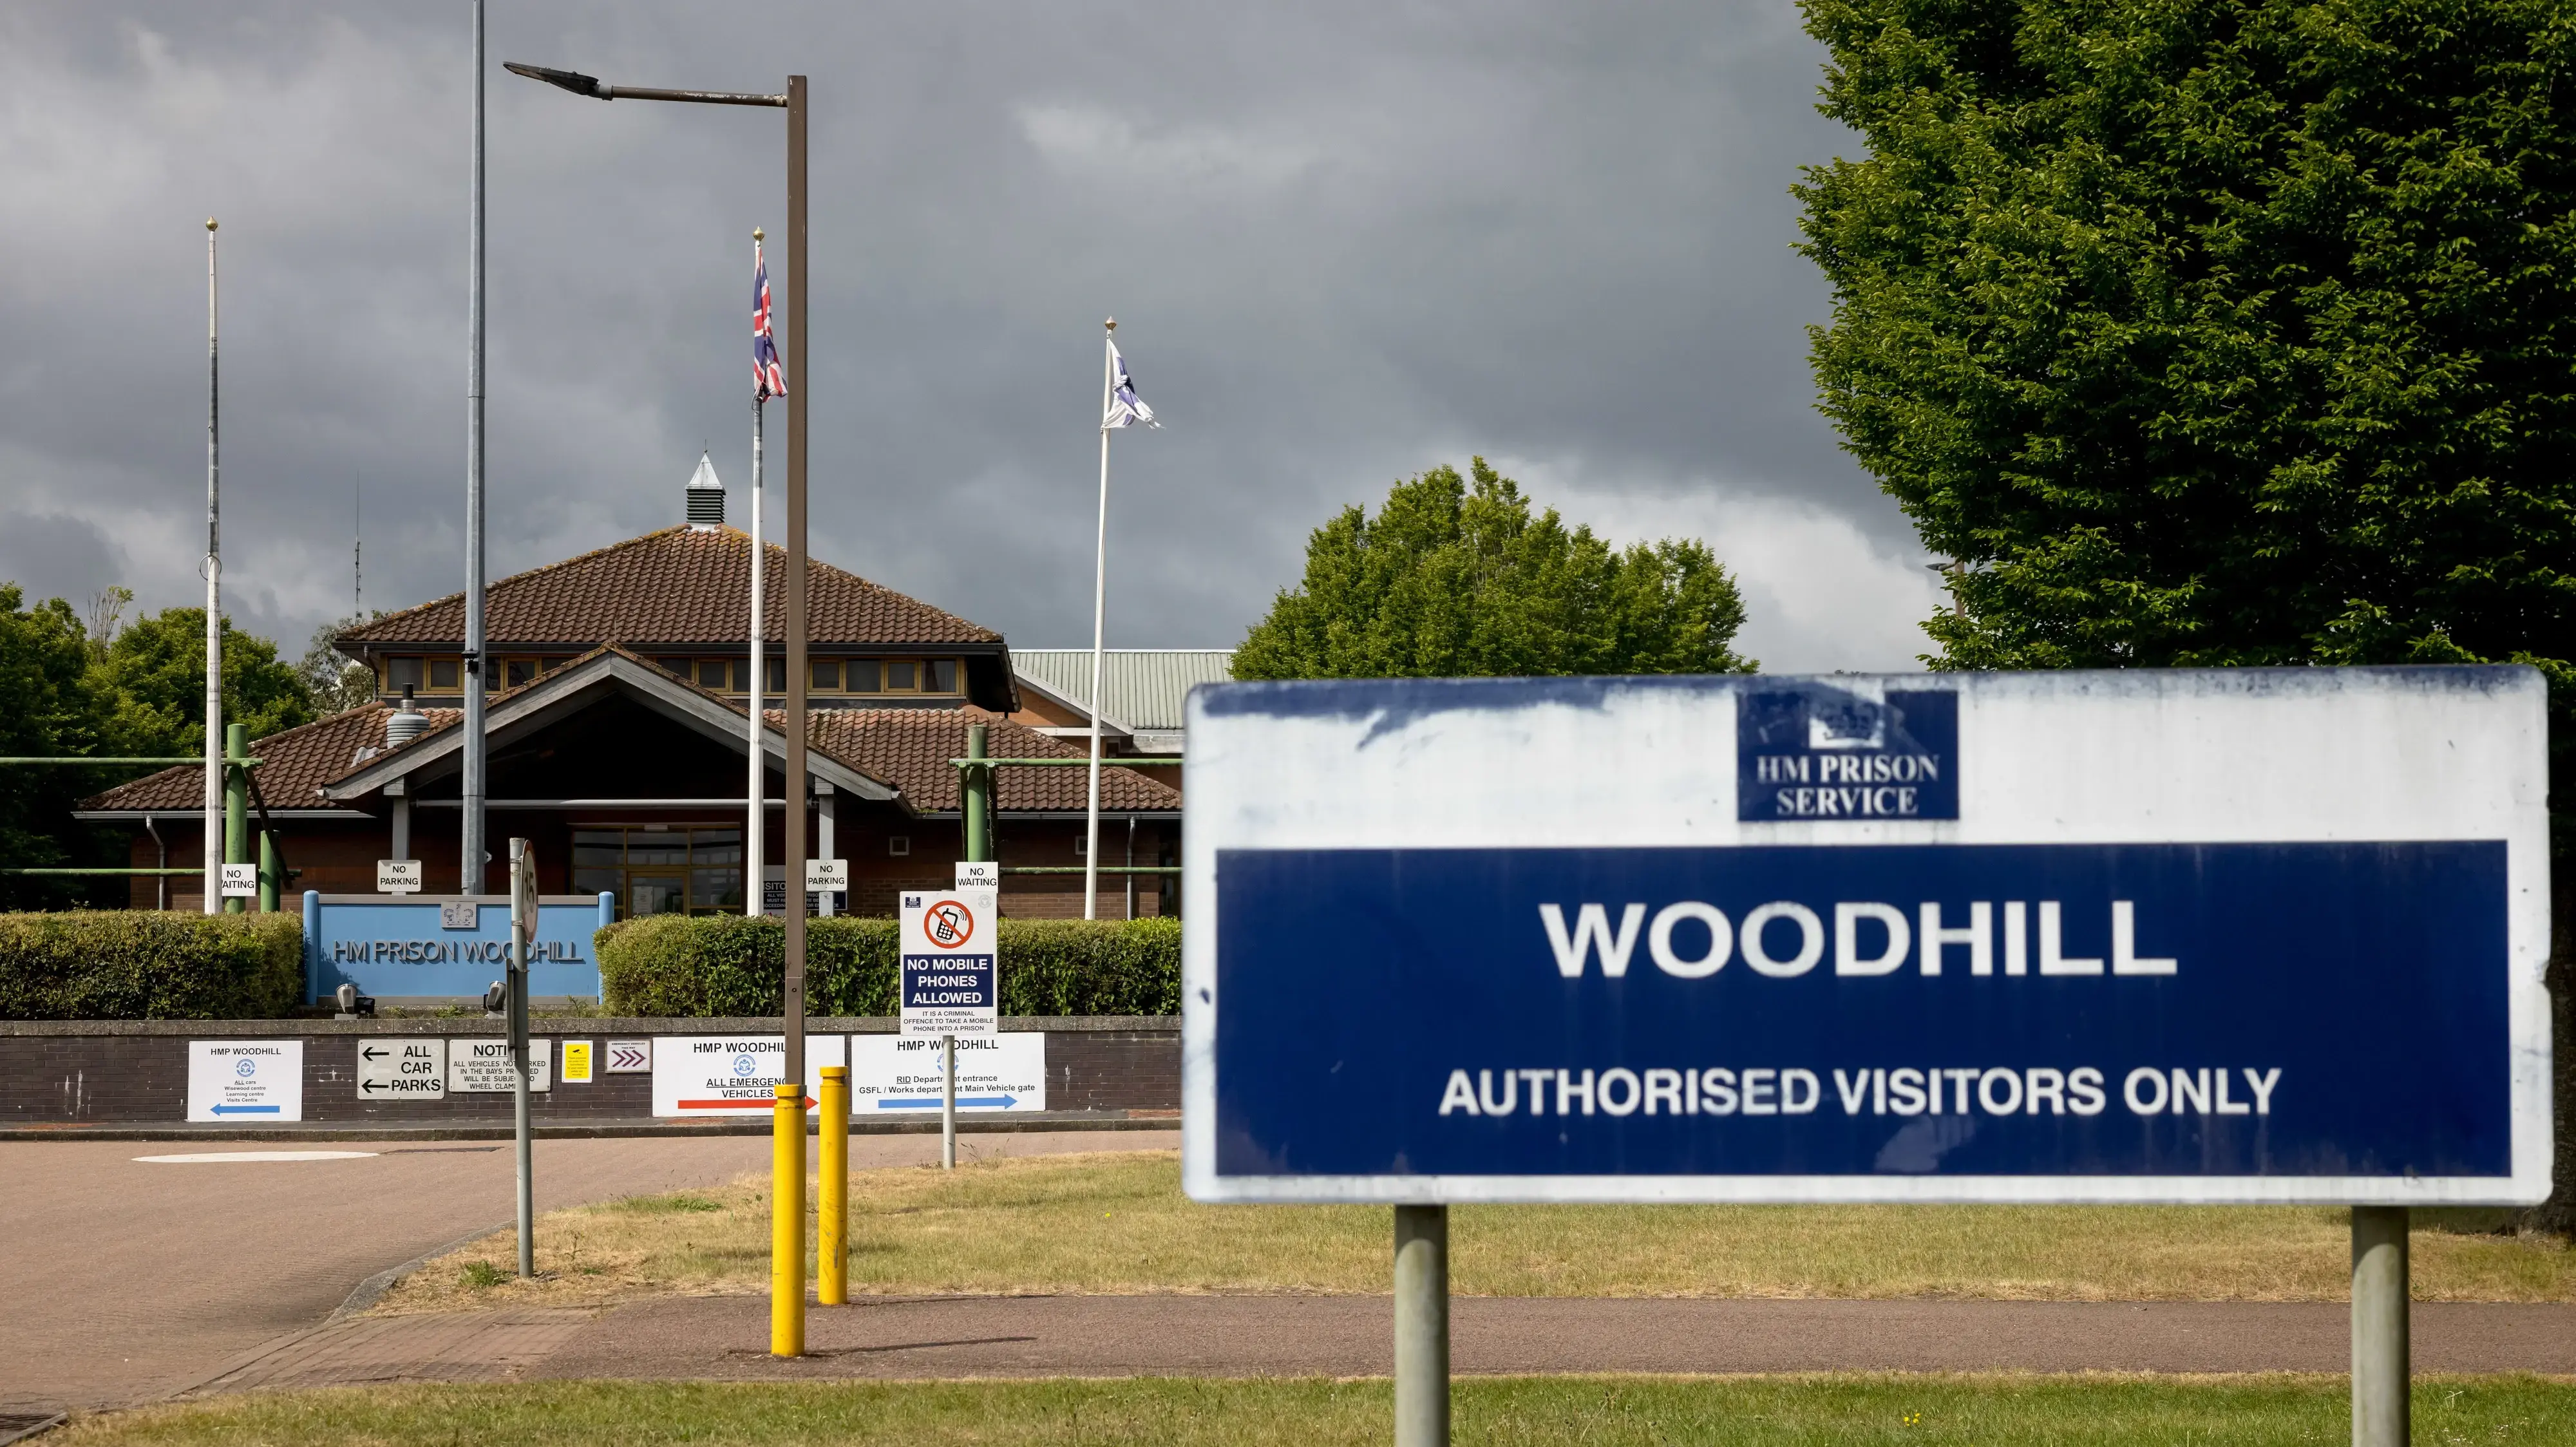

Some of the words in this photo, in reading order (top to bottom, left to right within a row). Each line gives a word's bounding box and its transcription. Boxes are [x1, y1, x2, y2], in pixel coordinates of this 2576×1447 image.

[1757, 755, 1810, 784] HM
[1819, 754, 1940, 784] PRISON
[1776, 787, 1918, 816] SERVICE
[222, 880, 254, 888] AITING
[525, 871, 535, 905] 15
[1540, 900, 2177, 978] WOODHILL
[334, 941, 368, 961] HM
[374, 941, 457, 961] PRISON
[907, 959, 929, 970] NO
[933, 959, 988, 970] MOBILE
[918, 976, 977, 987] PHONES
[913, 992, 982, 1004] ALLOWED
[474, 1045, 507, 1055] NOTI
[694, 1043, 721, 1053] HMP
[726, 1043, 785, 1053] WOODHIL
[898, 1041, 925, 1050] HMP
[929, 1039, 999, 1050] WODHILL
[404, 1046, 431, 1057] ALL
[401, 1062, 432, 1073] CAR
[392, 1079, 441, 1092] PARKS
[730, 1078, 785, 1086] EMERGEN
[914, 1076, 960, 1084] Departnt
[722, 1090, 773, 1098] VEHICLES
[916, 1086, 963, 1094] departnt
[1439, 1068, 1819, 1118] AUTHORISED
[1833, 1068, 2106, 1118] VISITORS
[2123, 1066, 2283, 1117] ONLY
